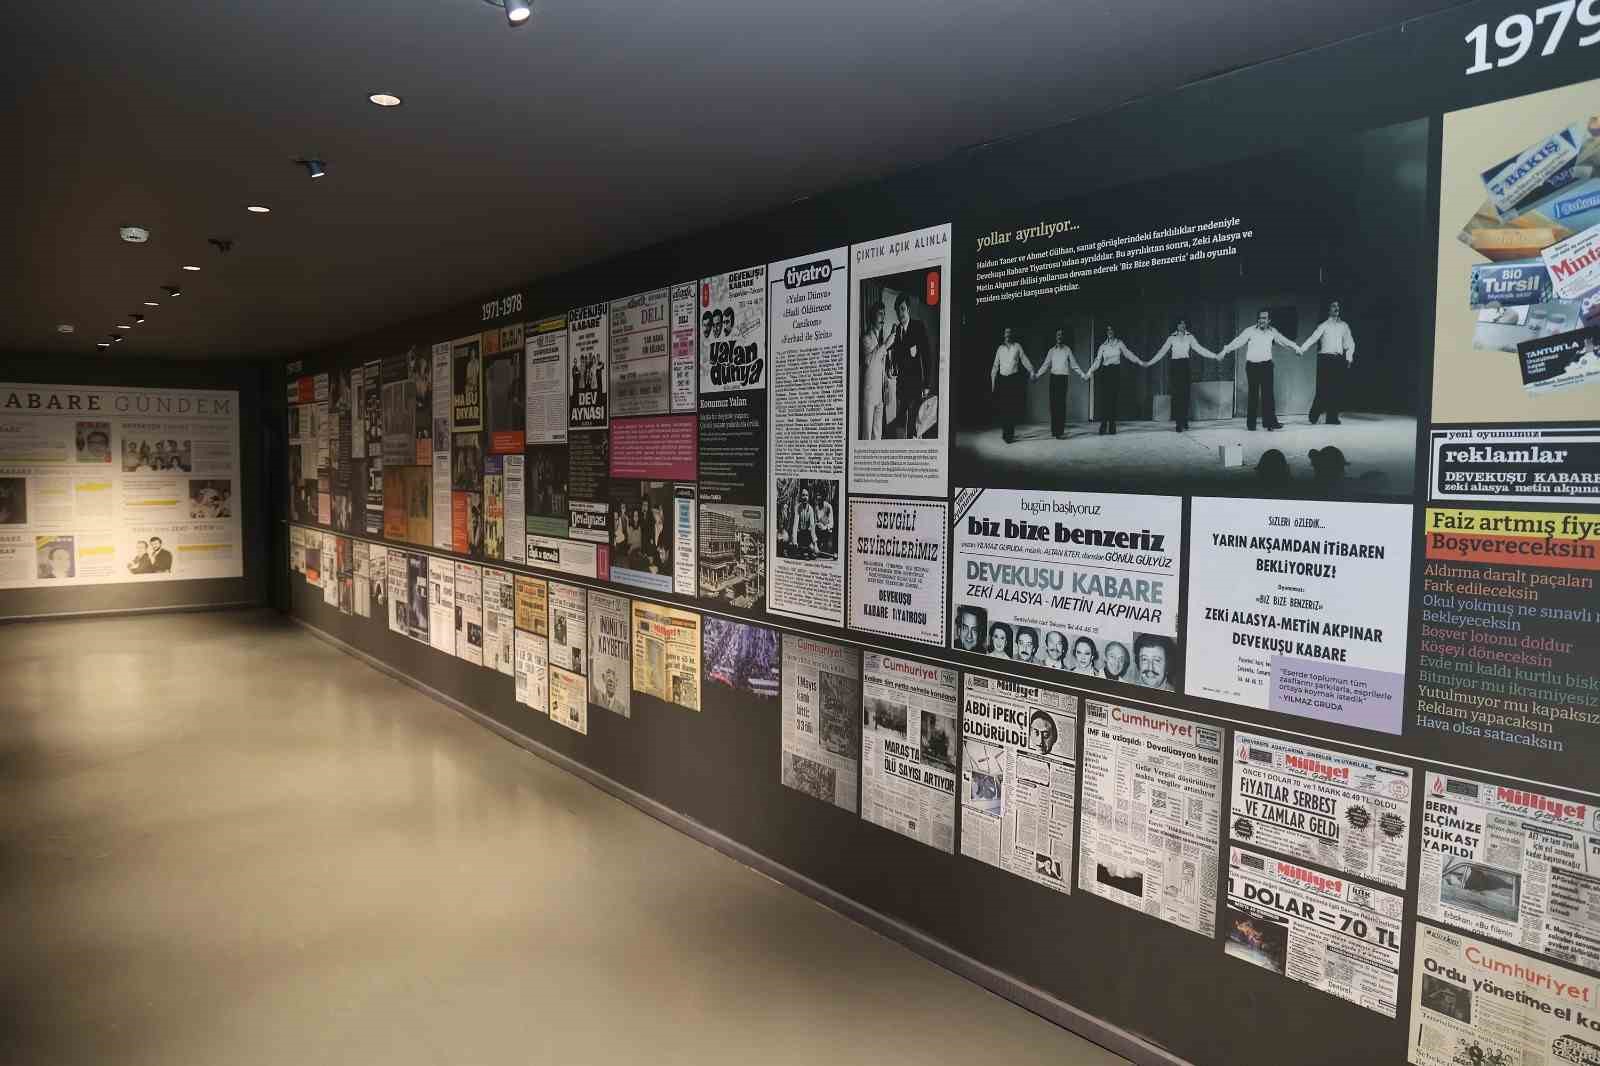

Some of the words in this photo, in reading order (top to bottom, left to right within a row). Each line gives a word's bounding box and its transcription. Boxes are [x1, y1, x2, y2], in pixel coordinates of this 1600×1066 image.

[856, 245, 884, 264] ÇIKTIK
[889, 241, 910, 256] AÇIK
[915, 231, 948, 249] ALINLA
[976, 231, 1012, 252] yollar
[1016, 219, 1080, 243] ayrılıyor...
[1026, 251, 1048, 261] Ahmet
[1077, 242, 1096, 252] sanat
[1197, 216, 1241, 232] nedeniyle
[1116, 250, 1126, 259] Bu
[1165, 239, 1191, 252] sonra,
[1192, 234, 1211, 247] Zeki
[1212, 230, 1241, 244] Alasya
[1242, 230, 1253, 239] ve
[1069, 269, 1092, 279] devam
[1093, 263, 1118, 275] ederek
[1189, 250, 1206, 261] adlı
[1207, 246, 1237, 260] oyunla
[786, 265, 830, 286] tiyatro
[1484, 276, 1540, 292] Tursil
[481, 293, 523, 321] 1971-1978
[710, 340, 758, 365] yalan
[710, 358, 763, 386] dünya
[578, 391, 598, 406] DEV
[571, 406, 605, 421] AYNASI
[1448, 429, 1472, 440] yeni
[1476, 431, 1541, 441] oyunumuz
[1445, 446, 1568, 463] reklamlar
[1445, 471, 1528, 485] DEVEKUŞU
[1445, 483, 1468, 492] zeki
[1470, 483, 1509, 494] alasya
[1515, 484, 1550, 493] metin
[1021, 496, 1051, 515] bugün
[1052, 500, 1101, 517] başlıyoruz
[876, 509, 917, 531] SEVGİLİ
[1268, 515, 1291, 527] SİZLERİ
[1433, 512, 1474, 530] Faiz
[1479, 514, 1556, 538] artmış
[968, 516, 1000, 537] biz
[1004, 518, 1050, 542] bize
[1054, 521, 1165, 552] benzeriz
[1212, 532, 1248, 549] YARIN
[1250, 537, 1320, 555] AKŞAMDAN
[1323, 541, 1385, 560] İTİBAREN
[1433, 533, 1595, 559] Boşvereceksin
[1105, 551, 1135, 565] GÖNÜL
[1137, 554, 1172, 568] GÜLYÜZ
[1255, 558, 1337, 579] BEKLİYORUZ!
[966, 560, 1064, 591] DEVEKUŞU
[1072, 574, 1164, 605] KABARE
[1424, 564, 1480, 580] Aldırma
[1484, 568, 1526, 584] daralt
[1530, 572, 1592, 589] paçaları
[1273, 596, 1287, 607] BİZE
[1424, 579, 1453, 593] Fark
[1457, 581, 1538, 601] edileceksin
[863, 603, 889, 619] KABARE
[966, 584, 993, 599] ZEKİ
[995, 588, 1043, 606] ALASYA
[1051, 595, 1094, 614] METİN
[1096, 602, 1162, 623] AKPINAR
[1423, 595, 1454, 608] Okul
[1457, 598, 1514, 617] yokmuş
[1518, 604, 1537, 617] ne
[1540, 607, 1592, 624] sınavlı
[1205, 607, 1229, 622] ZEKİ
[1323, 622, 1383, 643] AKPINAR
[1422, 610, 1521, 632] Bekleyeceksin
[1232, 632, 1293, 655] DEVEKUŞU
[1296, 642, 1347, 662] KABARE
[1422, 624, 1468, 641] Boşver
[1471, 630, 1518, 648] lotonu
[1521, 636, 1574, 653] doldur
[1421, 639, 1465, 657] Köşeyi
[1468, 645, 1553, 667] döneceksin
[883, 657, 938, 680] Cumhuriyet
[1309, 672, 1348, 686] toplumun
[1349, 679, 1368, 688] tüm
[1420, 655, 1451, 670] Evde
[1455, 660, 1473, 672] mi
[1477, 661, 1512, 679] kaldı
[1515, 667, 1562, 685] kurtlu
[1279, 684, 1303, 694] ortaya
[1304, 685, 1334, 698] koymak
[1419, 670, 1478, 690] Bitmiyor
[1481, 679, 1505, 694] mu
[1283, 694, 1313, 706] YILMAZ
[1314, 700, 1344, 711] GRUDA
[1418, 684, 1500, 709] Yutulmuyor
[1504, 702, 1528, 714] mu
[965, 700, 990, 718] ABDİ
[993, 703, 1028, 730] İPEKÇİ
[1111, 707, 1193, 738] Cumhuriyet
[1417, 699, 1467, 719] Reklam
[1471, 710, 1553, 734] yapacaksın
[963, 719, 1027, 748] ÖLDÜRÜLDÜ
[1416, 714, 1450, 731] Hava
[1453, 721, 1481, 737] olsa
[1484, 728, 1564, 751] satacaksın
[1146, 741, 1197, 761] Devalüasyon
[1198, 753, 1218, 765] kesin
[1285, 755, 1349, 779] Milliyet
[924, 771, 955, 793] ARTIYOR
[1267, 772, 1292, 785] DOLAR
[1318, 785, 1340, 797] MARK
[1240, 776, 1289, 801] FİYATLAR
[1293, 789, 1337, 815] SERBEST
[1425, 800, 1458, 816] BERN
[1496, 786, 1586, 820] Milliyet
[1245, 799, 1259, 815] VE
[1261, 803, 1305, 830] ZAMLAR
[1425, 812, 1482, 835] ELÇİMİZE
[1422, 838, 1474, 860] YAPILDI
[1424, 828, 1480, 849] SUİKAST
[1275, 862, 1342, 893] Milliyet
[1375, 925, 1400, 950] TL
[1465, 946, 1590, 1002] Cumhuriyet
[1424, 957, 1467, 984] Ordu
[1472, 978, 1553, 1014] yönetime
[1554, 1004, 1571, 1022] el
